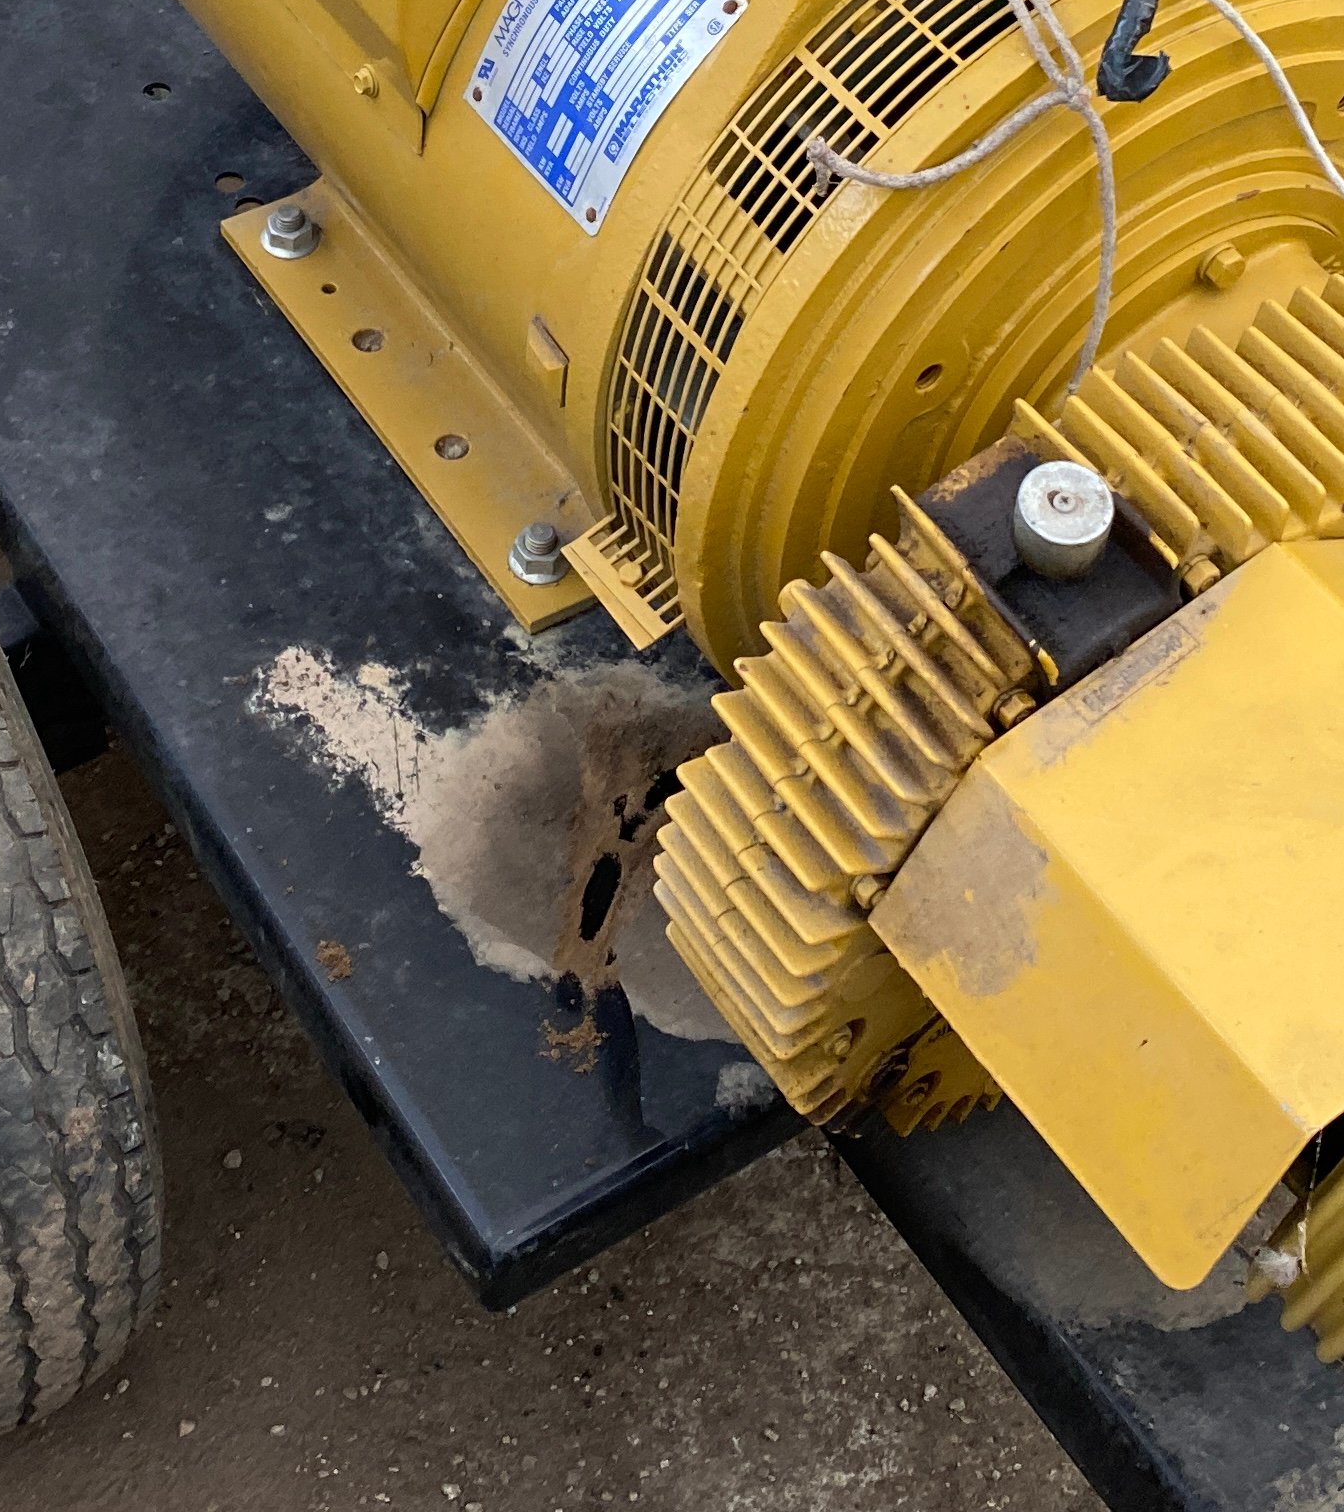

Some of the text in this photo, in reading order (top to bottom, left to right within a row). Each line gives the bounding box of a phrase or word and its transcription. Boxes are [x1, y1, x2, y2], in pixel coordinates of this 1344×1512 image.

[564, 15, 584, 40] PHASE
[568, 16, 616, 85] CONTINUOUS DUTY
[524, 134, 538, 156] FIELD
[534, 110, 549, 133] AMPS
[577, 30, 594, 52] FIELD
[593, 4, 613, 30] VOLTS
[526, 106, 541, 131] CLASS
[571, 27, 585, 46] RISE
[583, 14, 595, 28] BY
[568, 79, 585, 104] VOLTS
[585, 40, 631, 107] STANDBY SERVICE
[614, 43, 685, 135] MARATHON
[574, 87, 590, 111] AMPS
[586, 97, 603, 123] VOLTS
[591, 106, 608, 130] AMPS
